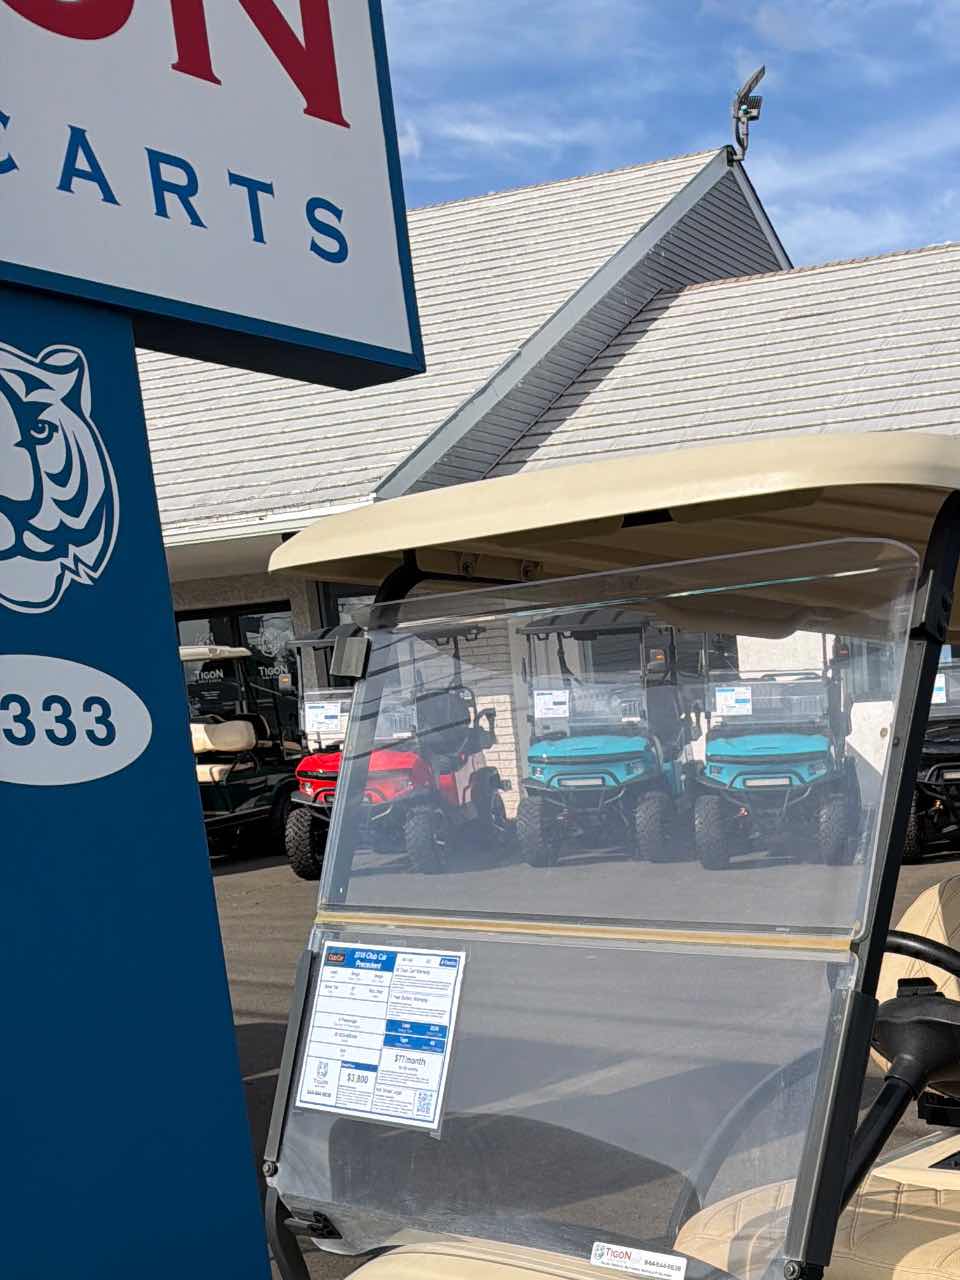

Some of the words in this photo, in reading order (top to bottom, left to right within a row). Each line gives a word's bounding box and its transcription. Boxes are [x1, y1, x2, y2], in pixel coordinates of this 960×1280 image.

[195, 669, 224, 679] TIGON
[258, 665, 288, 675] TIGON
[606, 1247, 632, 1261] TIGON
